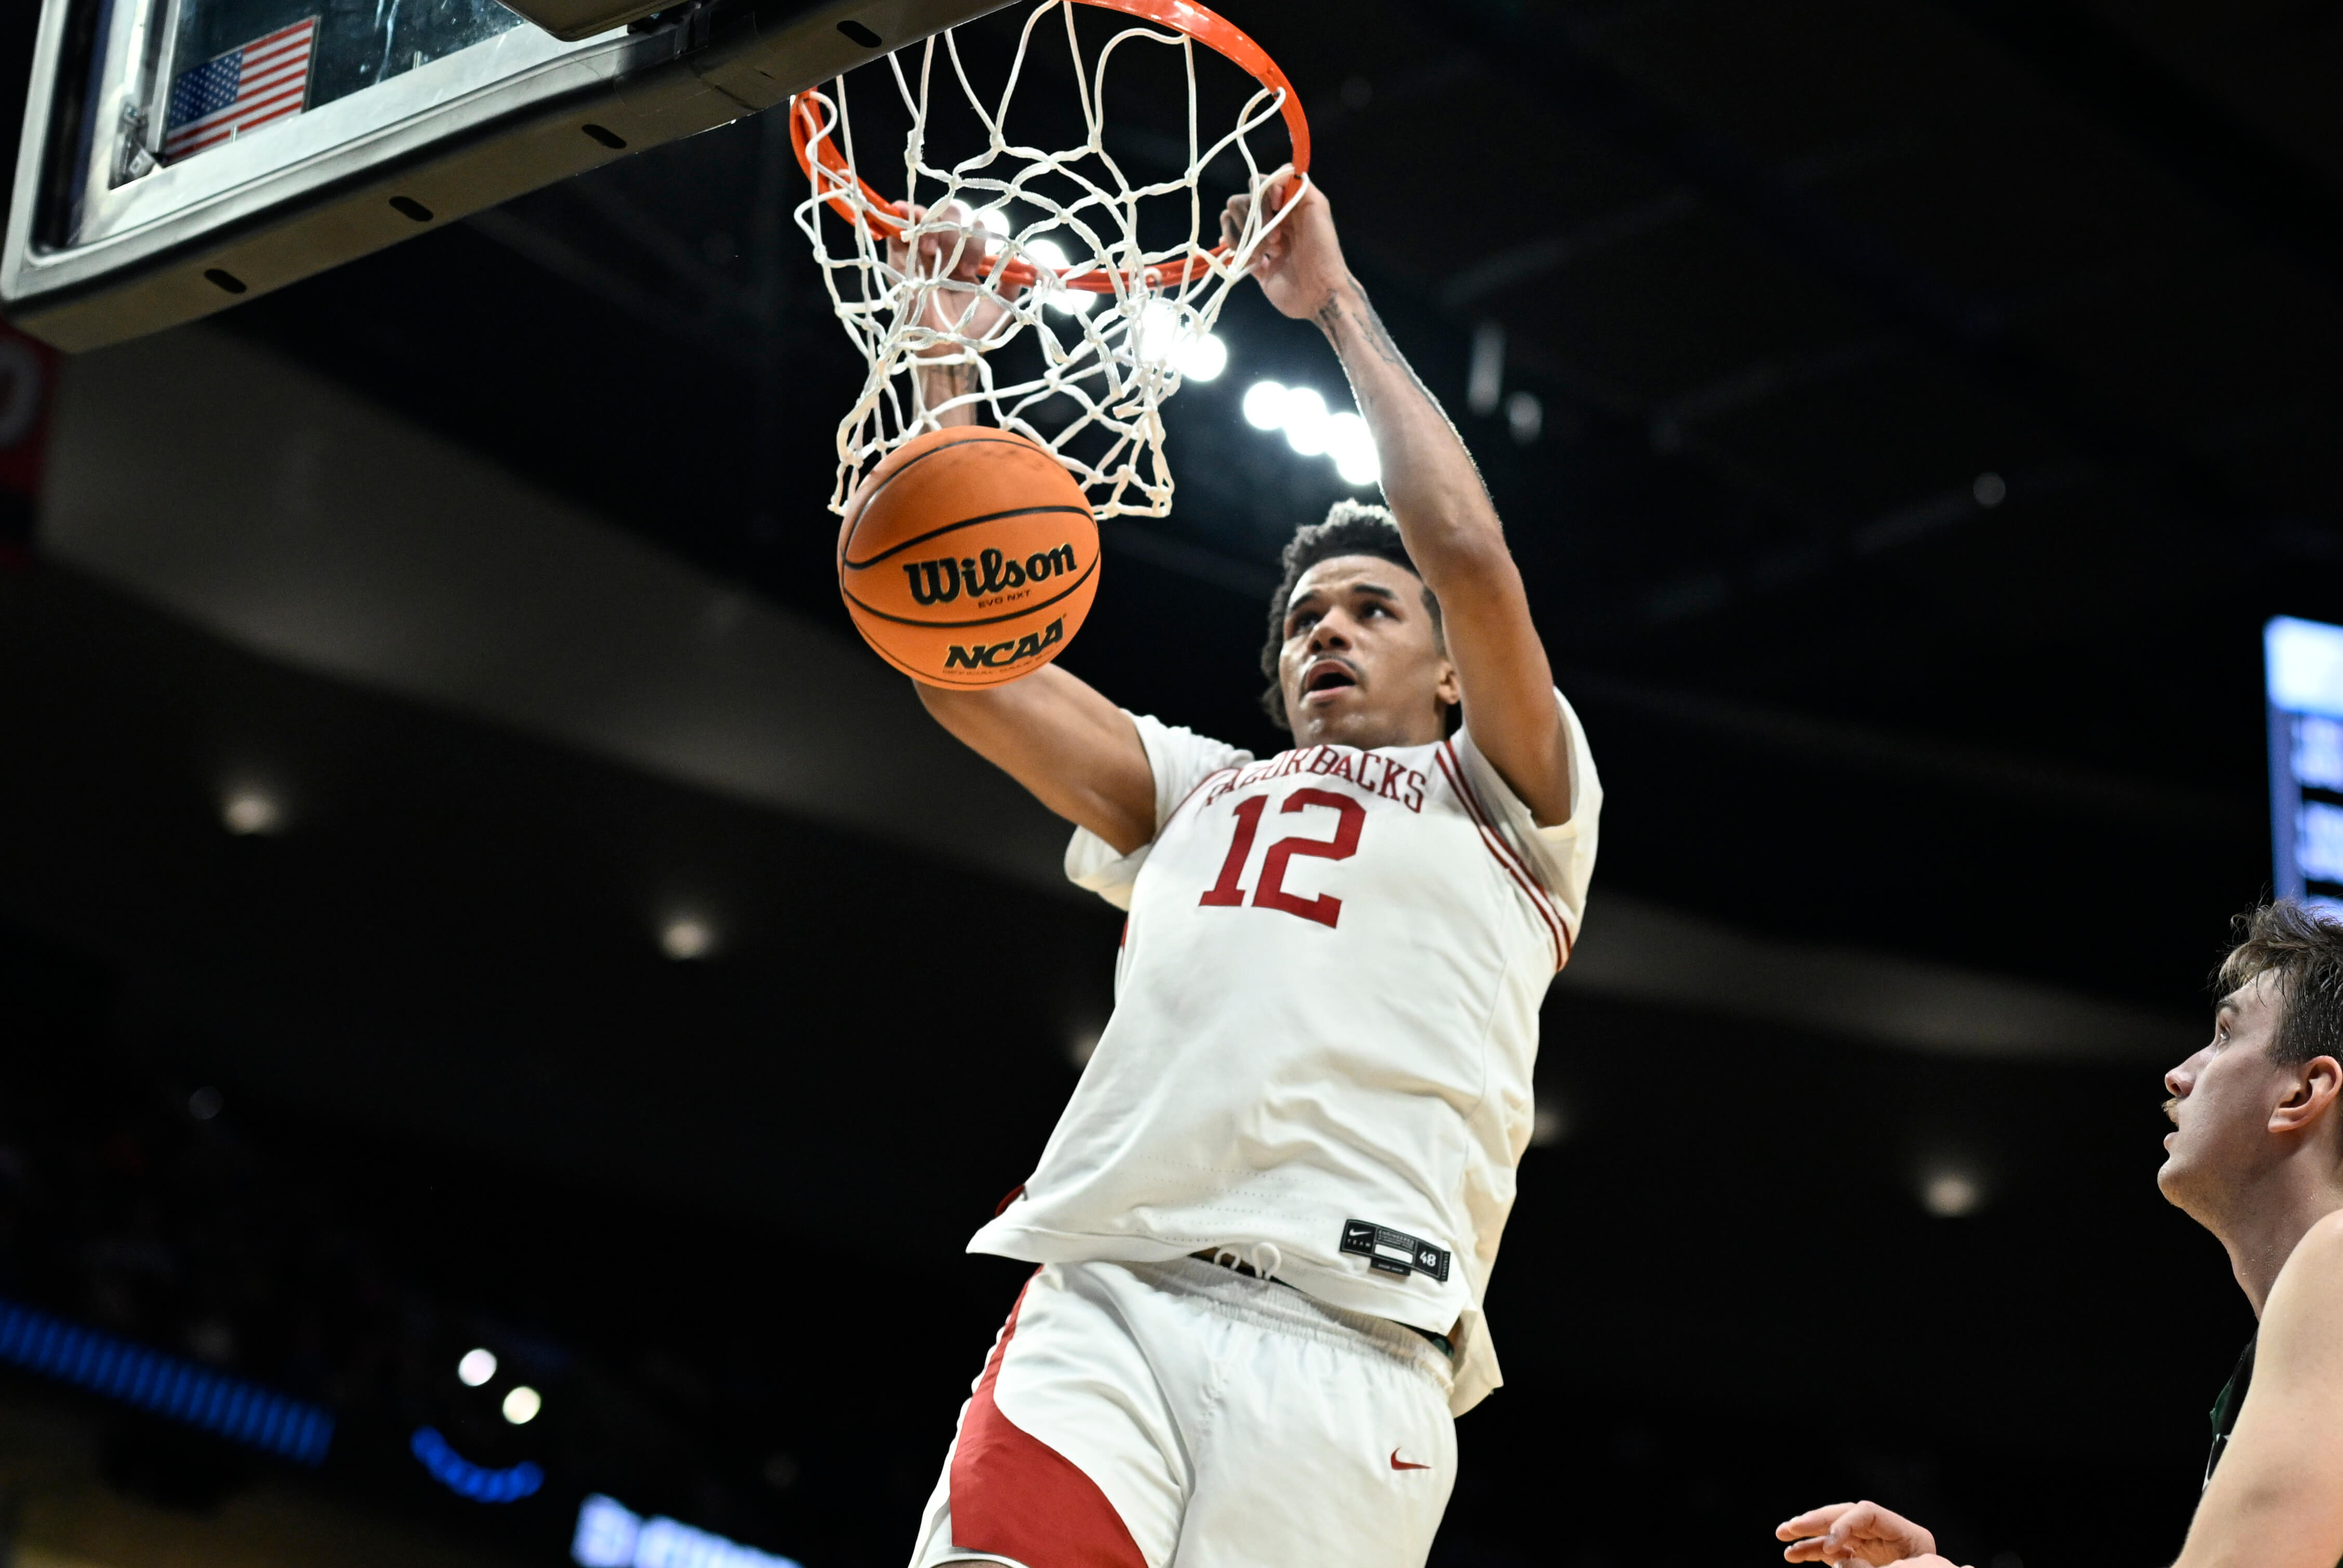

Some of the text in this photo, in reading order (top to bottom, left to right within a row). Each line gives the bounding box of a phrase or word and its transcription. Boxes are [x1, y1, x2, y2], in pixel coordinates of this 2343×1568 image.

[903, 542, 1077, 606] Wilson
[978, 589, 1030, 609] EVO NXT
[944, 617, 1064, 669] NCAA
[1199, 788, 1367, 929] 12
[1419, 1251, 1436, 1267] 48
